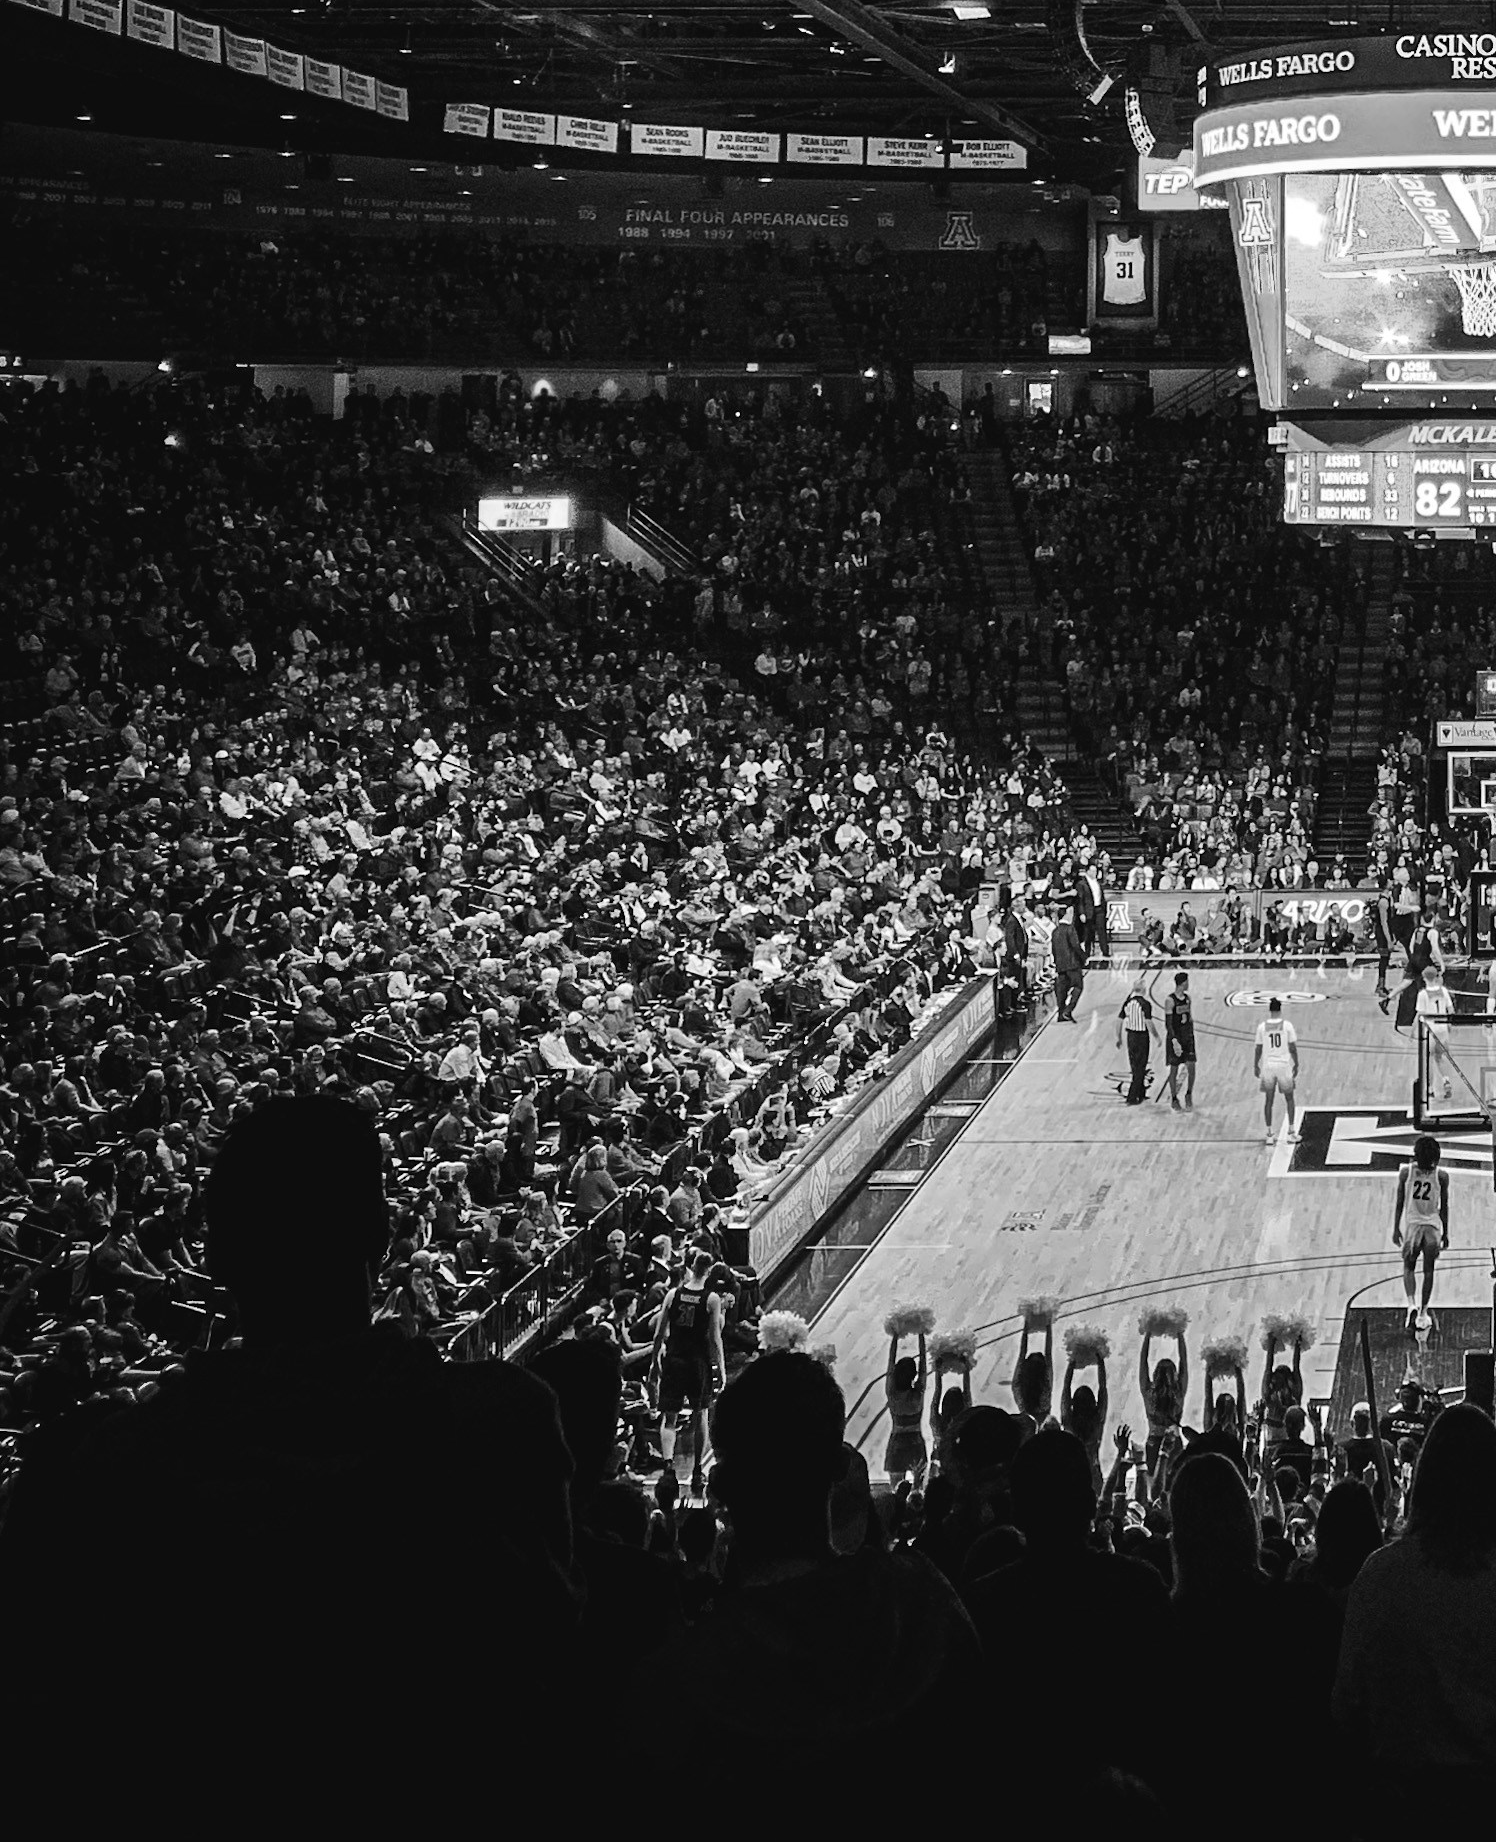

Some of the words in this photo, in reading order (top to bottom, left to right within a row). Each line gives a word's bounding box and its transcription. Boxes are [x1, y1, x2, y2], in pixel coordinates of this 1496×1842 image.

[1219, 57, 1274, 87] WELLS
[1276, 51, 1356, 78] FARGO
[1201, 122, 1250, 157] WELLS
[1250, 113, 1342, 149] FARGO
[884, 140, 907, 150] STEVE
[965, 142, 981, 151] BOB
[877, 150, 932, 158] M-BASKETBALL
[1144, 172, 1189, 194] TEP
[625, 209, 674, 224] FINAL
[680, 210, 725, 225] FOUR
[731, 211, 850, 228] APPEARANCES
[618, 226, 650, 239] 1988
[704, 228, 735, 241] 1997
[1116, 261, 1134, 279] 31
[1386, 361, 1400, 383] 0
[1401, 371, 1437, 382] GREEN
[1401, 360, 1431, 372] JOSH
[1324, 454, 1361, 468] ASSISTS
[1413, 459, 1466, 474] ARIZONA
[1318, 471, 1369, 485] TURNOVERS
[1320, 488, 1367, 502] REBOUNDS
[1415, 481, 1462, 518] 82
[503, 501, 553, 510] WILDCATS
[1316, 506, 1340, 520] BENCH
[1340, 506, 1372, 520] POINTS
[1384, 506, 1398, 520] 12
[1454, 727, 1493, 741] Vantage
[1268, 1032, 1282, 1049] 10
[1412, 1180, 1431, 1201] 22
